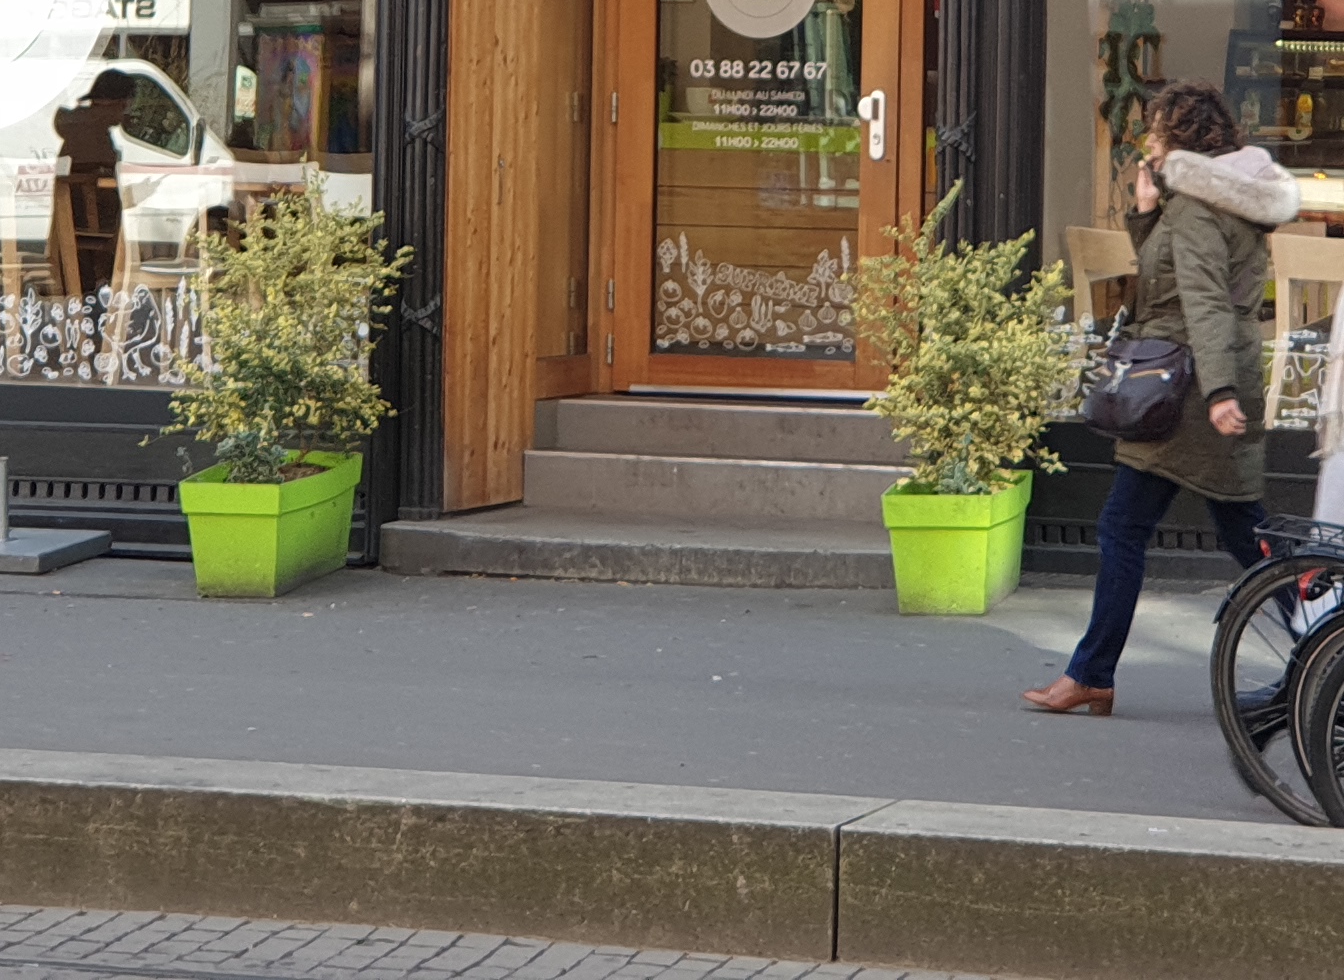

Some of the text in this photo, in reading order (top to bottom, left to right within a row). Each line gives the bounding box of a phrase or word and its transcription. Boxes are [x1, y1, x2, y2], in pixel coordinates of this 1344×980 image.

[690, 59, 827, 80] 03 88 22 67 67
[756, 90, 769, 100] AU
[770, 91, 805, 101] SAMEDI
[713, 103, 797, 116] 11H00 22H00
[692, 121, 746, 132] DIMANCHES
[761, 122, 791, 133] JOURS
[715, 135, 799, 148] 11H00 22H00
